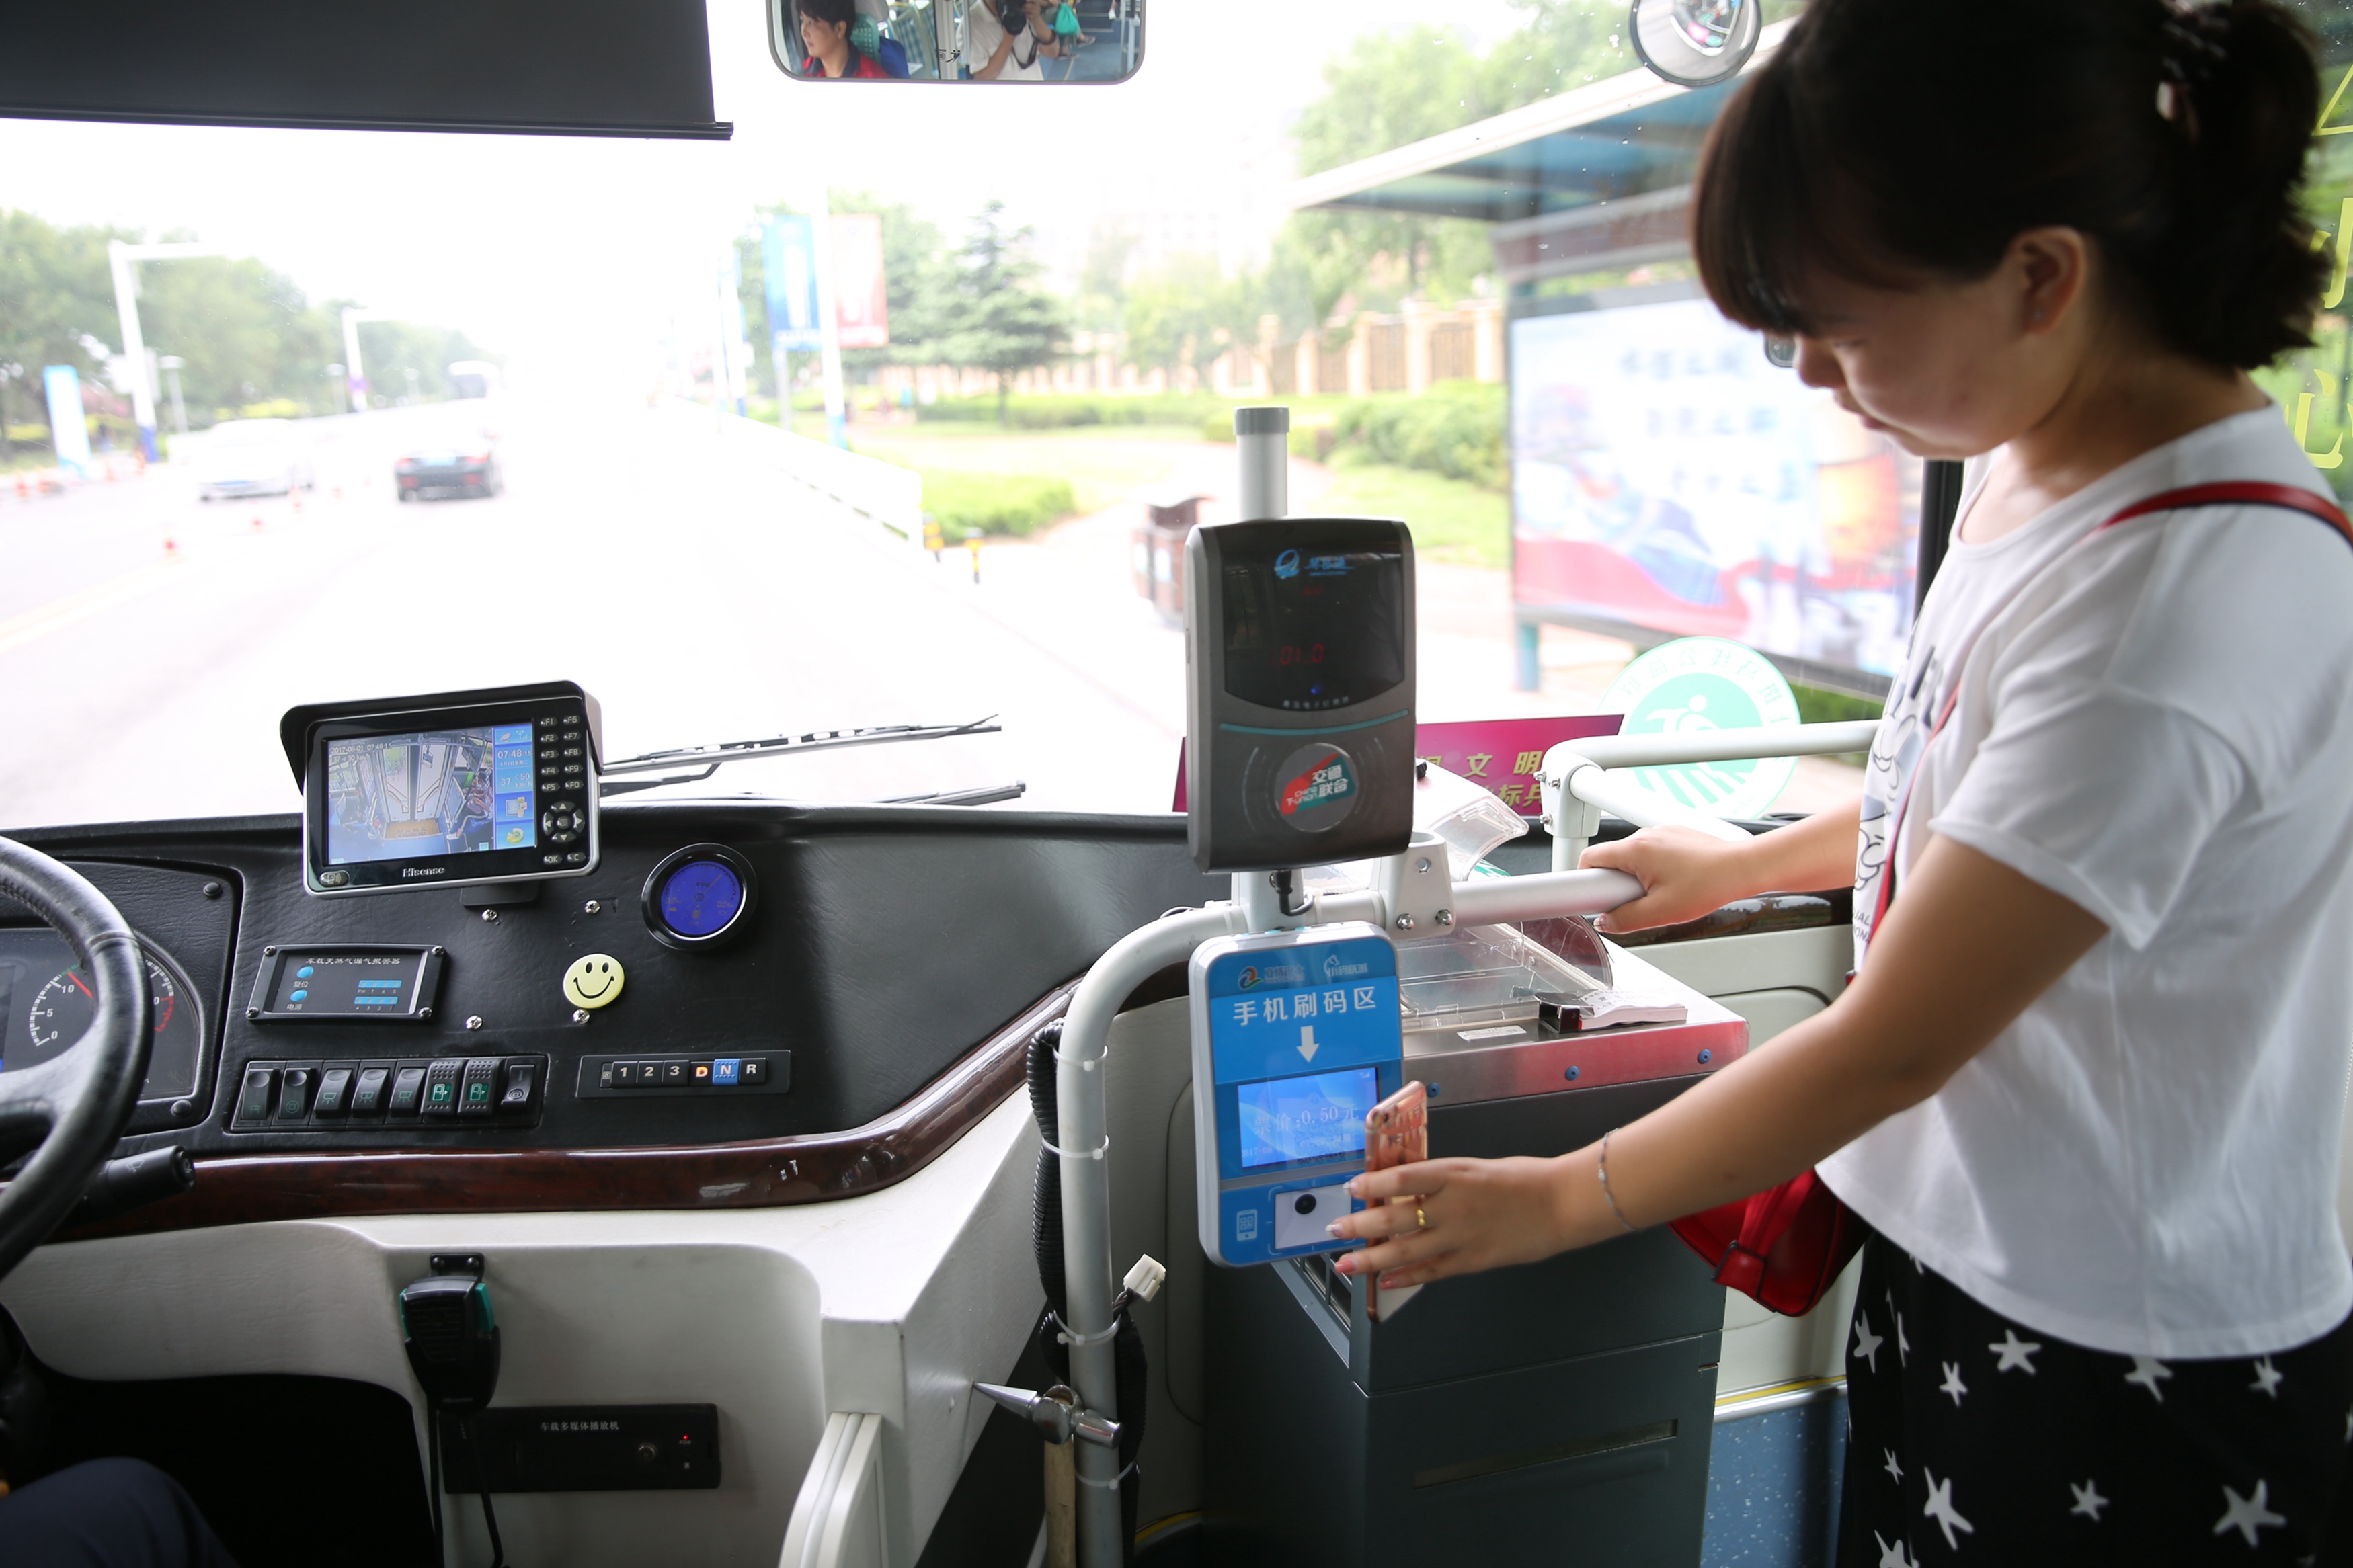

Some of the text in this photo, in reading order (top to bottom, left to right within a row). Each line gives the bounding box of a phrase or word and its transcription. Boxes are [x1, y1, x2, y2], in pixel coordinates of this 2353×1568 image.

[331, 742, 393, 754] 2017-08-01 07:48:15
[1312, 764, 1343, 785] 交通
[1318, 778, 1349, 798] 联合
[548, 855, 559, 863] OK
[402, 867, 445, 878] Hisense
[305, 957, 401, 965] 车载天然气漏气报警器
[61, 984, 75, 993] 10
[1233, 986, 1376, 1026] 手机刷码区
[46, 1008, 53, 1017] 5
[51, 1030, 58, 1039] 0
[620, 1063, 757, 1077] 1 2 3 D N R
[541, 1421, 620, 1432] 车载多媒体播放机
